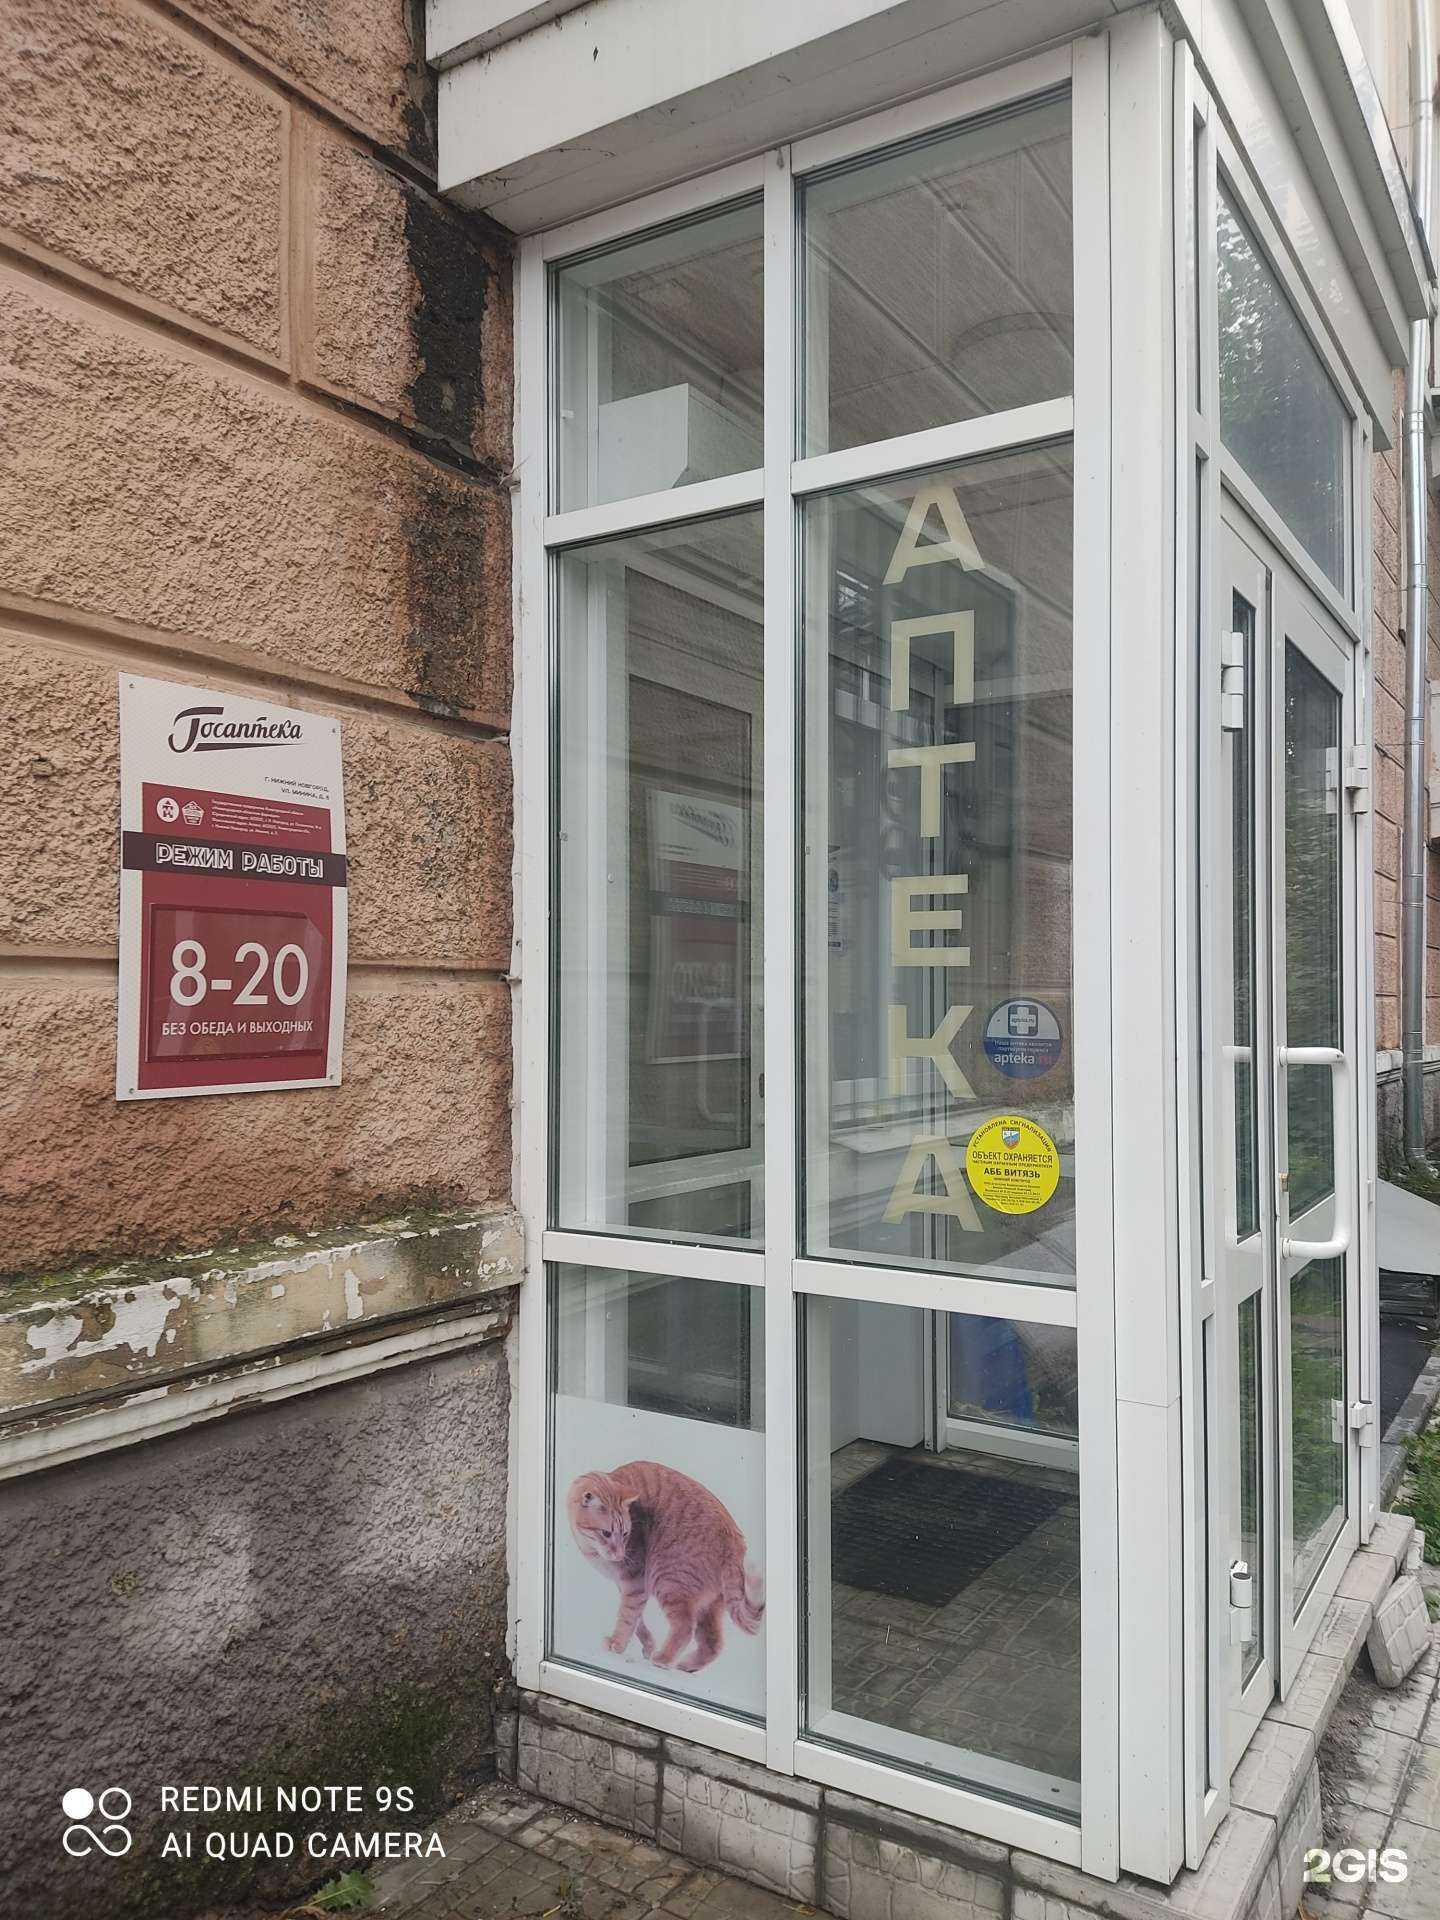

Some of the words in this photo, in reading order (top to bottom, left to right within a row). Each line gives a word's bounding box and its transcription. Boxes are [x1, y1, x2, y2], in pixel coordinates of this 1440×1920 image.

[168, 706, 303, 753] Госаптека
[155, 842, 234, 870] РЕЖИМ
[241, 851, 324, 879] РАБОТЫ
[882, 485, 985, 1233] АПТЕКА
[169, 938, 309, 1007] 8-20
[162, 1022, 187, 1036] БЕЗ
[189, 1021, 235, 1035] ОБЕДА
[237, 1023, 247, 1034] И
[249, 1020, 314, 1034] ВЫХОДНЫХ
[972, 1150, 1002, 1161] ОБЪЕКТ
[1003, 1152, 1053, 1164] ОХРАНЯЕТСЯ
[983, 1167, 1002, 1176] АББ
[1004, 1168, 1041, 1179] ВИТЯЗЬ
